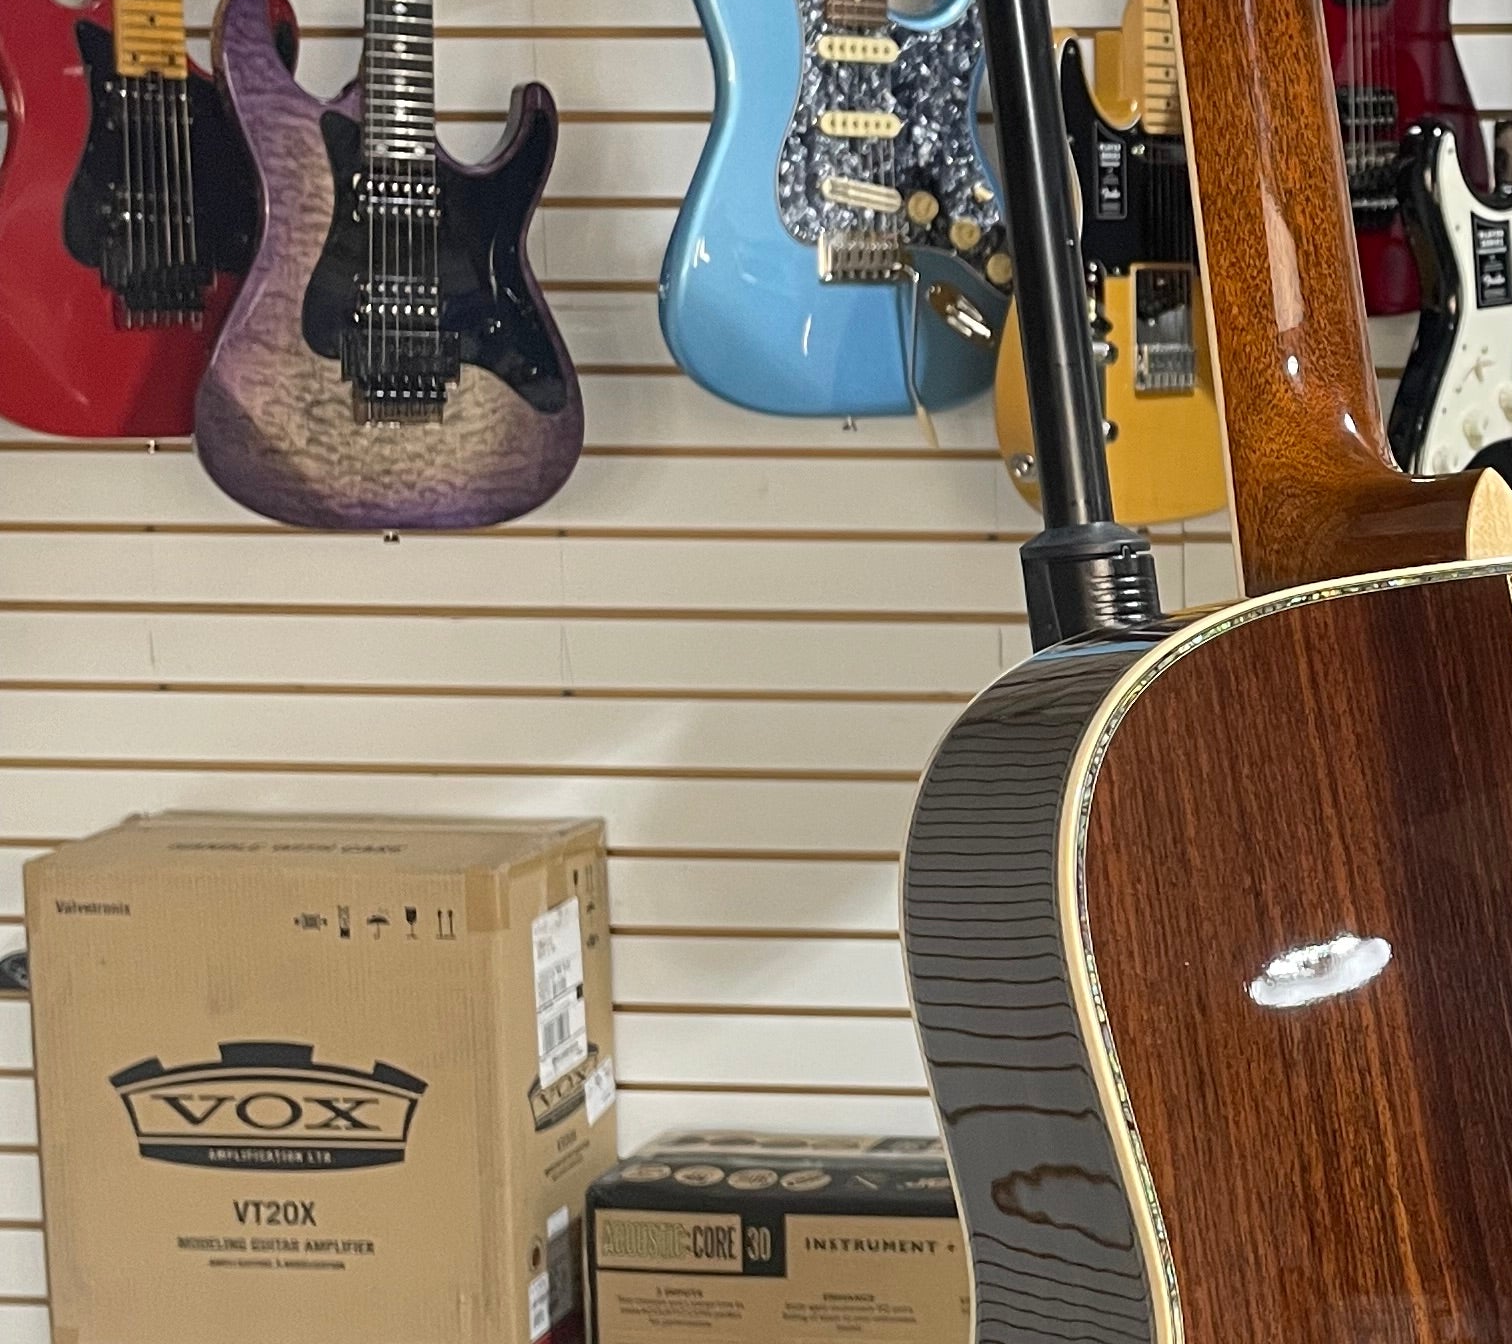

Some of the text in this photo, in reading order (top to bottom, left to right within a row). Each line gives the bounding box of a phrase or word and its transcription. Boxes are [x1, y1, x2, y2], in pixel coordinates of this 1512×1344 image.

[151, 1091, 382, 1131] VOX
[232, 1199, 318, 1228] VT20X
[804, 1236, 937, 1255] INSTRUMENT
